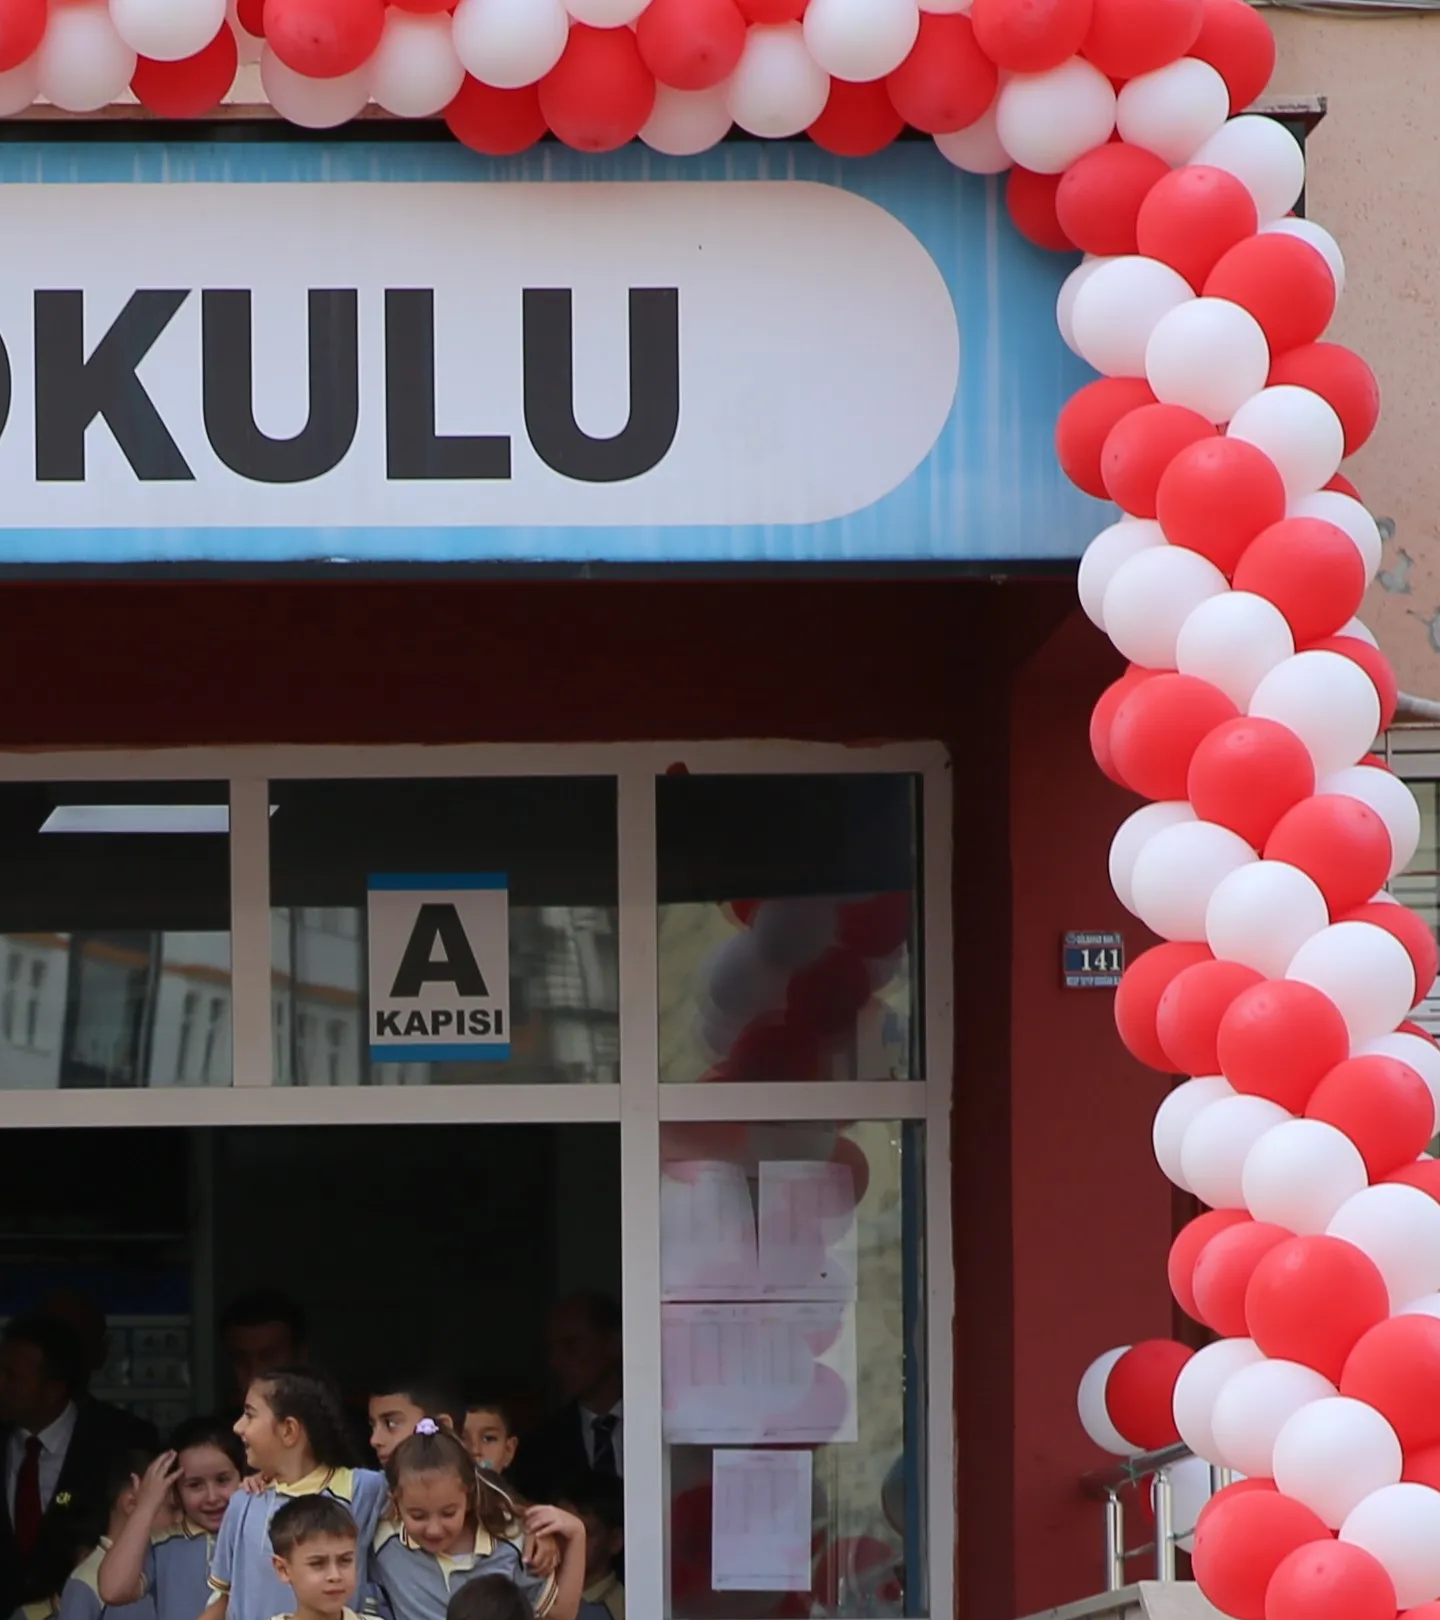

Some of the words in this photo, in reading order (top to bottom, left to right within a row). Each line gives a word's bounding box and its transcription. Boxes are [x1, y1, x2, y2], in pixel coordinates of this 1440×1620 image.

[389, 902, 490, 997] A
[1081, 948, 1121, 971] 141
[375, 1009, 503, 1036] KAPISI
